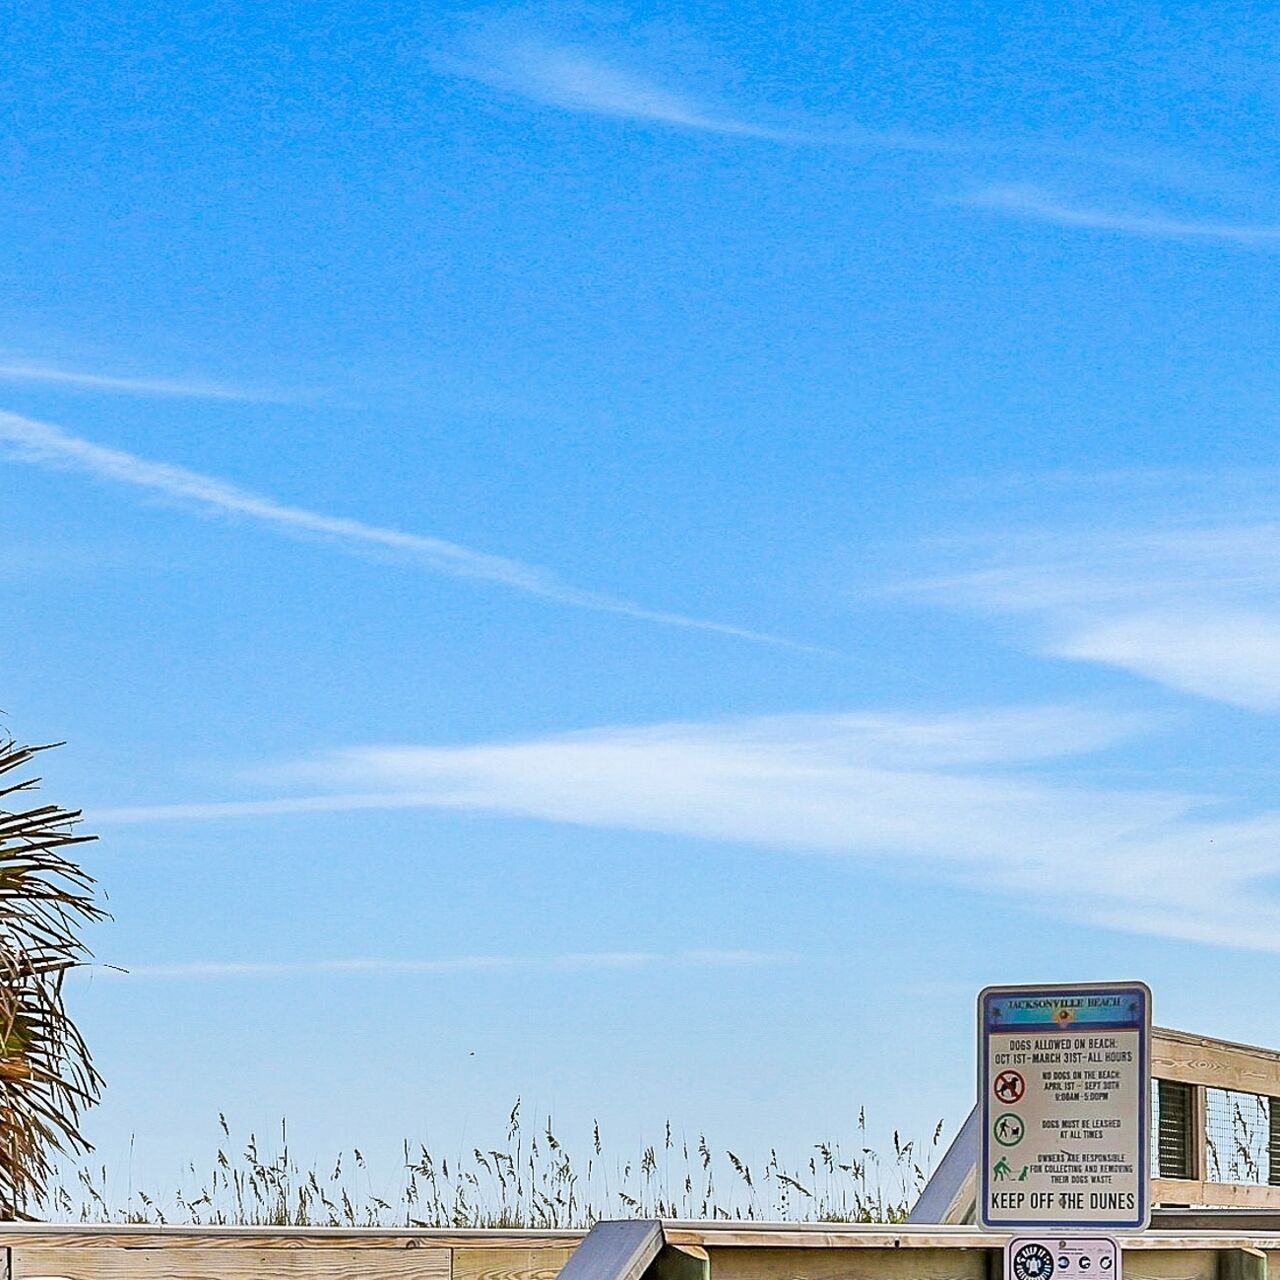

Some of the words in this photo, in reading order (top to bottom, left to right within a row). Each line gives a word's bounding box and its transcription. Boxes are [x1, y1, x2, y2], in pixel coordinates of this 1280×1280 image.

[1009, 999, 1084, 1009] JACKSONVILLE
[1087, 998, 1121, 1008] BEACH
[1010, 1040, 1031, 1050] DOGS
[1034, 1040, 1070, 1050] ALLOWED
[1074, 1039, 1085, 1049] ON
[1089, 1039, 1117, 1048] BEACH:
[995, 1054, 1010, 1064] OCT
[1105, 1052, 1132, 1062] HOURS
[1084, 1071, 1096, 1079] THE
[1044, 1082, 1062, 1090] APRIL
[1064, 1082, 1075, 1090] 1ST
[1085, 1082, 1100, 1090] SEPT
[1042, 1120, 1059, 1128] DOGS
[1062, 1120, 1079, 1128] MUST
[1082, 1120, 1090, 1128] BE
[1093, 1120, 1120, 1128] LEASHED
[1067, 1154, 1080, 1162] ARE
[1101, 1165, 1133, 1173] REMOVING
[992, 1193, 1024, 1209] KEEP
[1031, 1193, 1054, 1209] OFF
[1060, 1193, 1084, 1209] THE
[1090, 1193, 1135, 1209] DUNES
